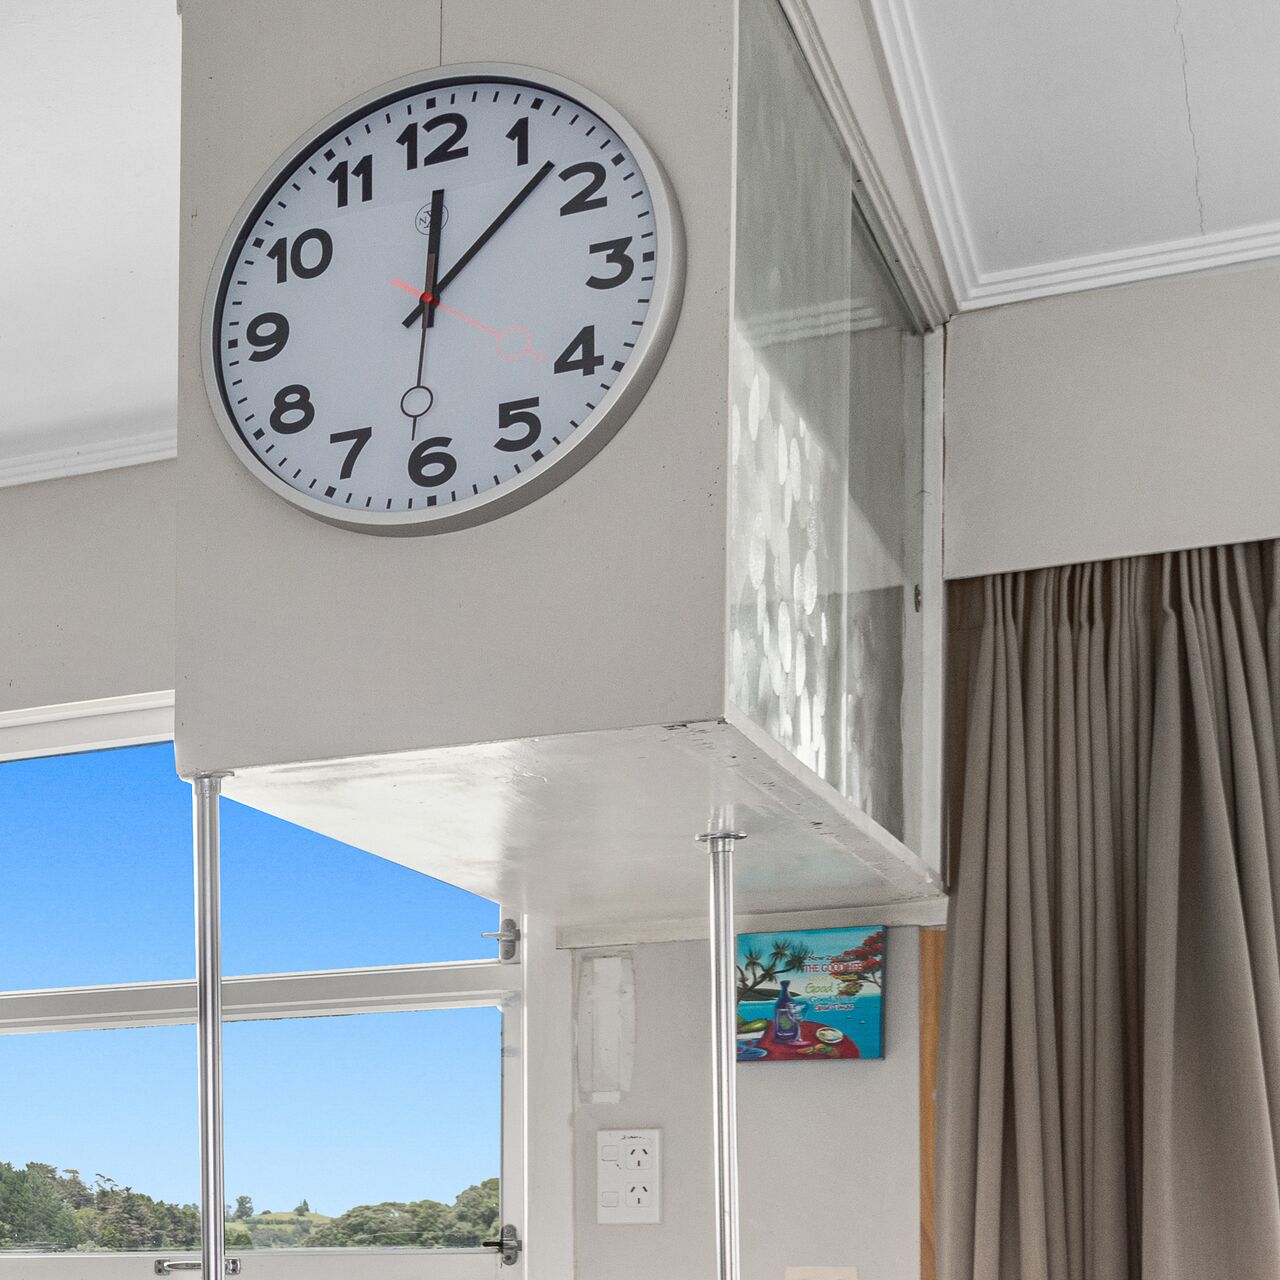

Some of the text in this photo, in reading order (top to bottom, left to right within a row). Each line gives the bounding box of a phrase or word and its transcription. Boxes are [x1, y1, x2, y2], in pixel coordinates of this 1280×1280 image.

[395, 113, 469, 171] 12
[505, 116, 530, 167] 1
[327, 154, 373, 209] 11
[557, 161, 608, 217] 2
[265, 228, 333, 284] 10
[585, 235, 635, 290] 3
[246, 312, 290, 363] 9
[554, 324, 605, 377] 4
[269, 384, 315, 435] 8
[493, 396, 542, 452] 5
[329, 426, 373, 480] 7
[407, 436, 457, 488] 6
